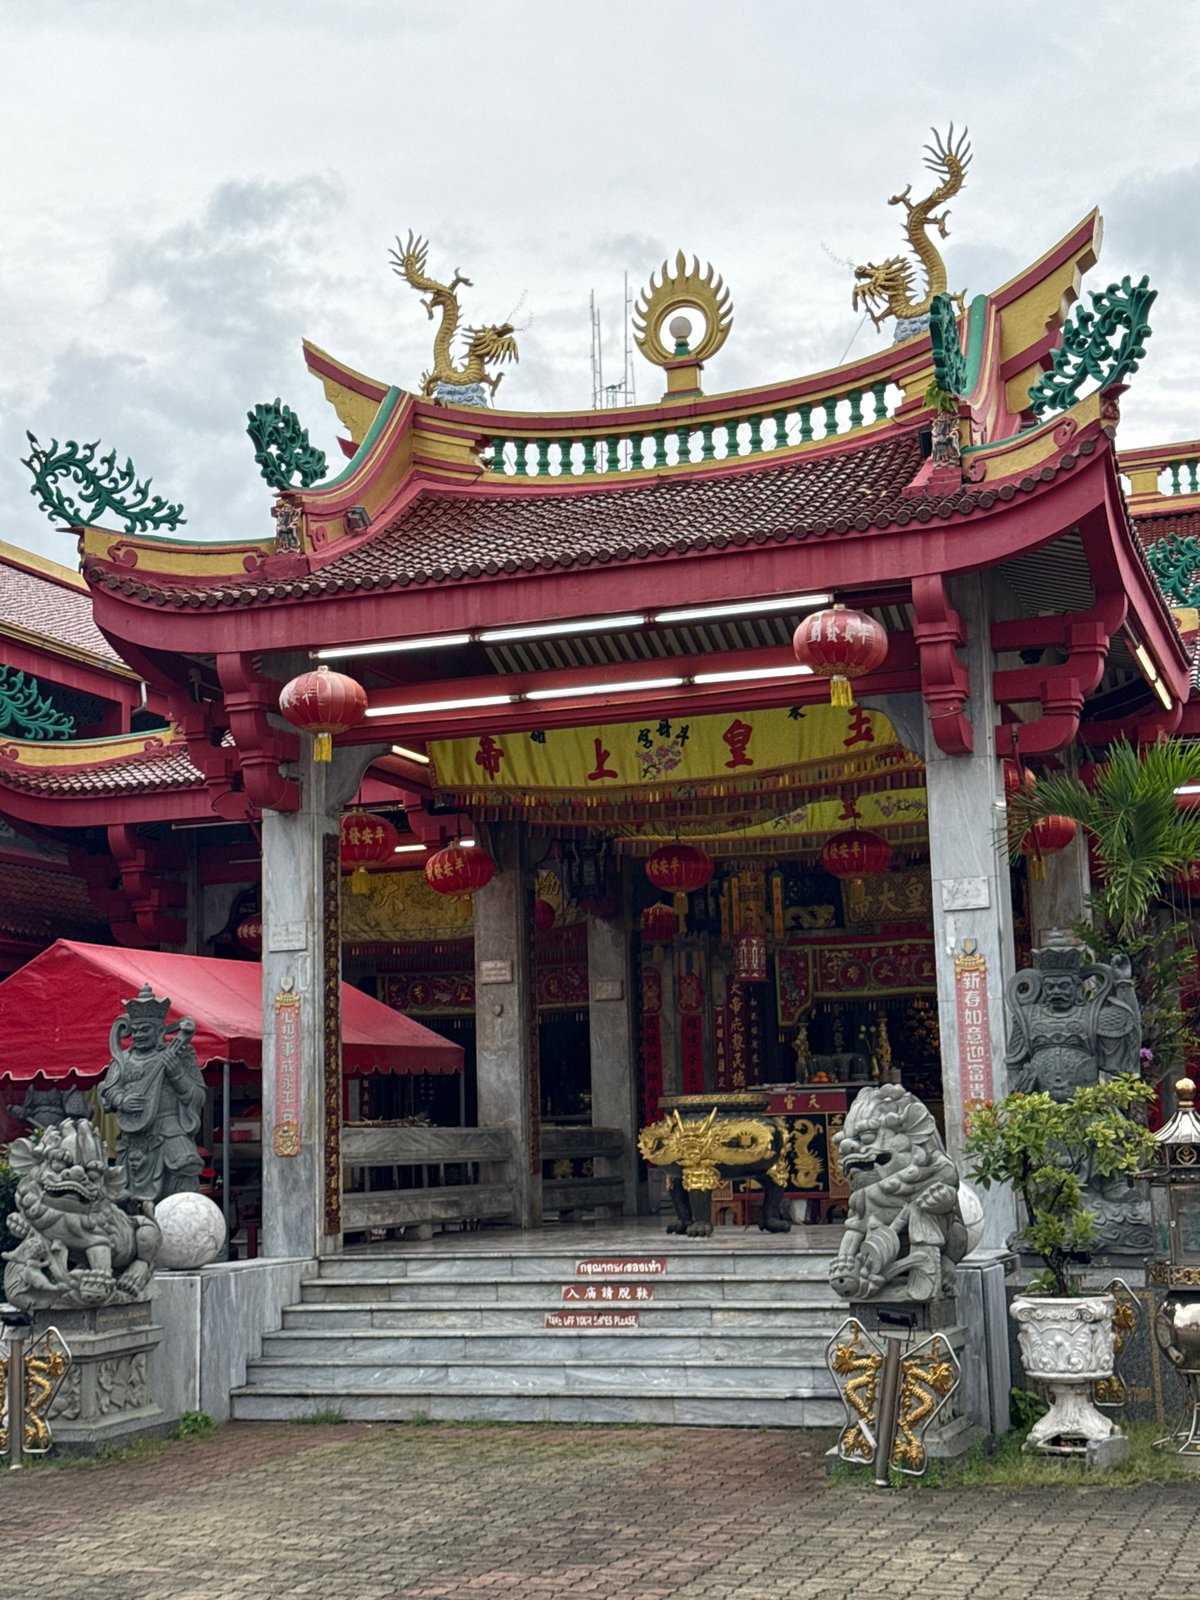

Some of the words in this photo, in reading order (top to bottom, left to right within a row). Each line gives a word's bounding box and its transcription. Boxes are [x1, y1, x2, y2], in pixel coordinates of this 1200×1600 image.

[962, 972, 986, 1100] 新春如意迎富貴
